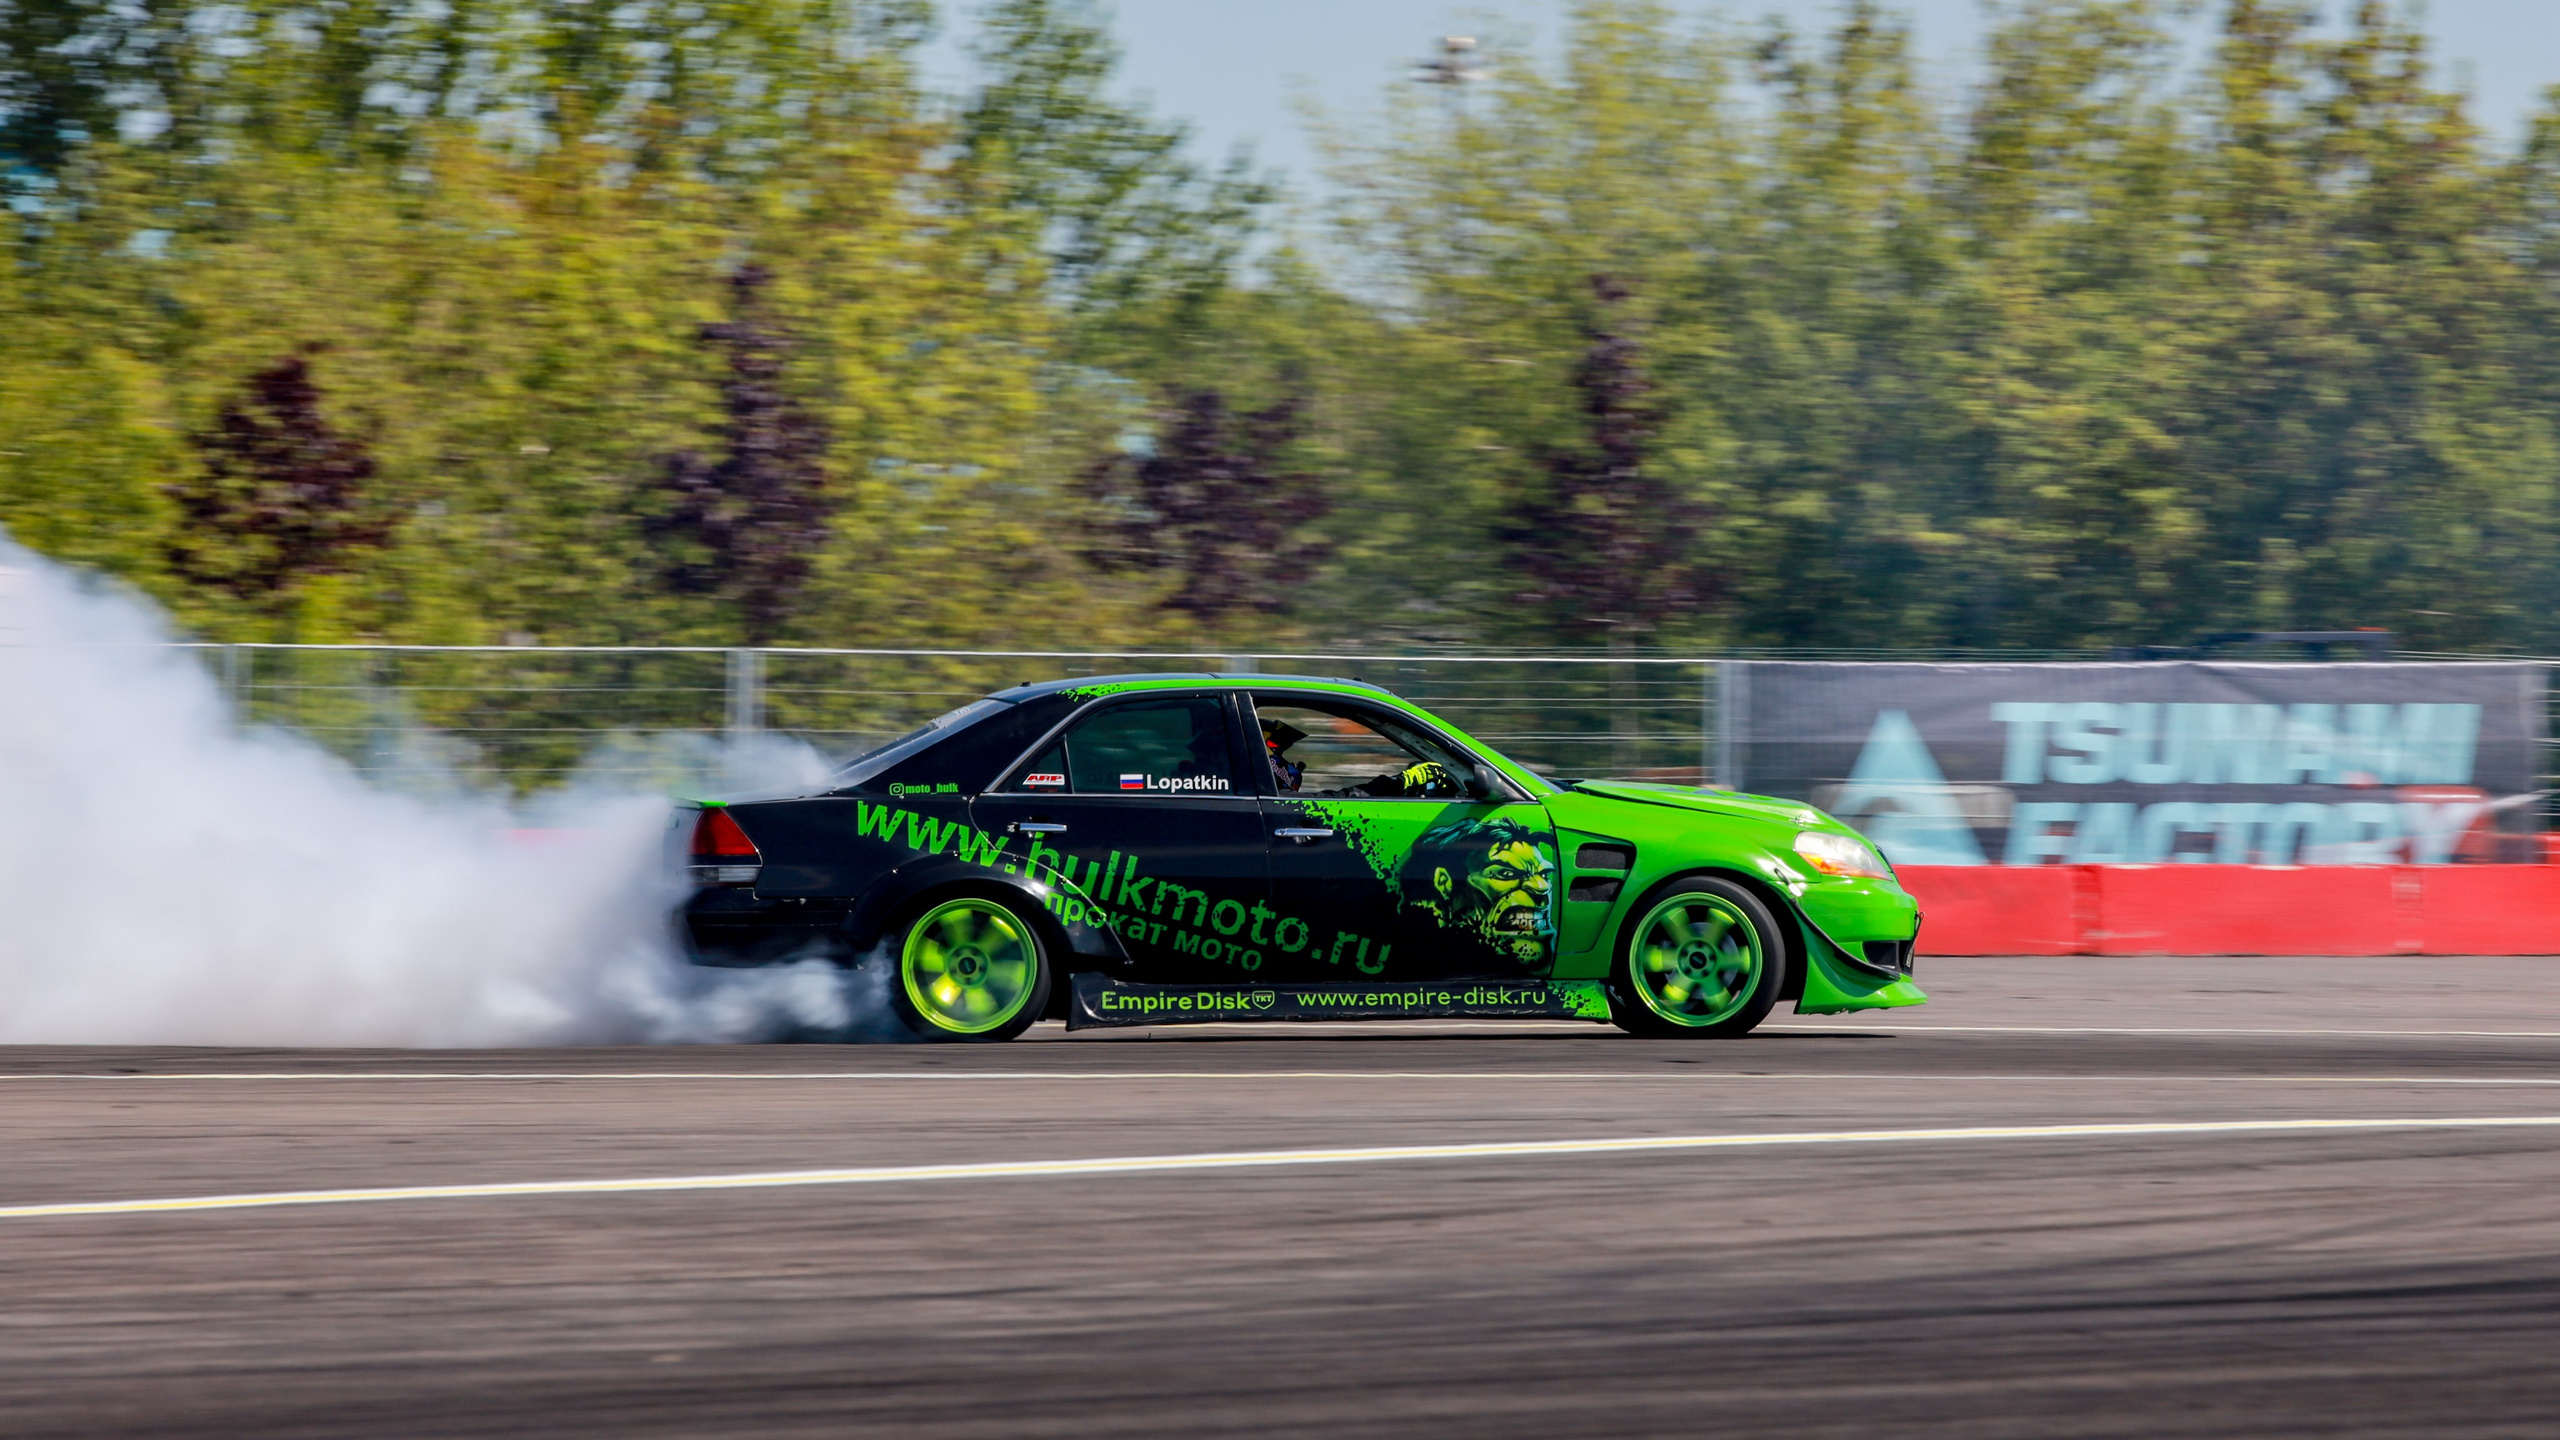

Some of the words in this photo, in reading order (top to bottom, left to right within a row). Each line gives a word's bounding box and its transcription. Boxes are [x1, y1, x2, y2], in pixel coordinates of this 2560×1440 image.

[1991, 702, 2483, 784] TSUNAMI
[905, 783, 959, 795] moto_hulk
[1147, 774, 1229, 793] Lopatkin
[2004, 802, 2488, 864] FACTORY
[857, 800, 1392, 975] www.hulkmoto.ru
[1043, 891, 1168, 945] прокат
[1102, 991, 1192, 1013] Empire
[1197, 992, 1251, 1010] Disk
[1297, 986, 1546, 1010] www.empire-disk.ru
